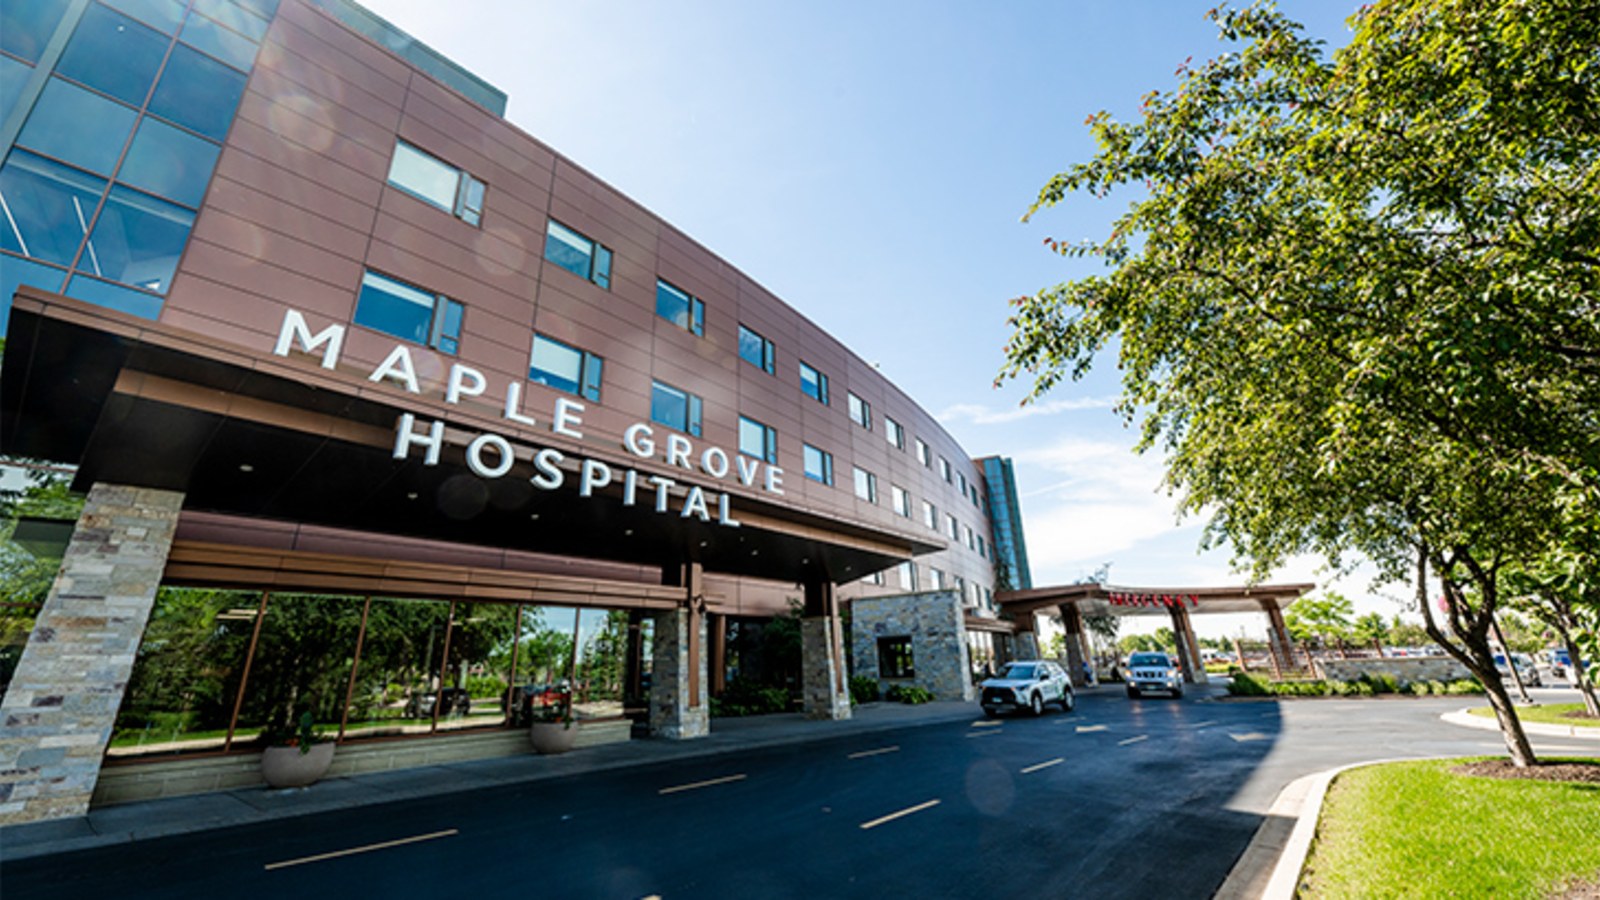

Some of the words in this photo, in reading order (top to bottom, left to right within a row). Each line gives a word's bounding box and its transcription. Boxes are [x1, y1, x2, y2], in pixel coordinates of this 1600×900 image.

[274, 308, 585, 439] MAPLE
[623, 423, 785, 495] GROVE
[392, 413, 741, 527] HOSPITAL
